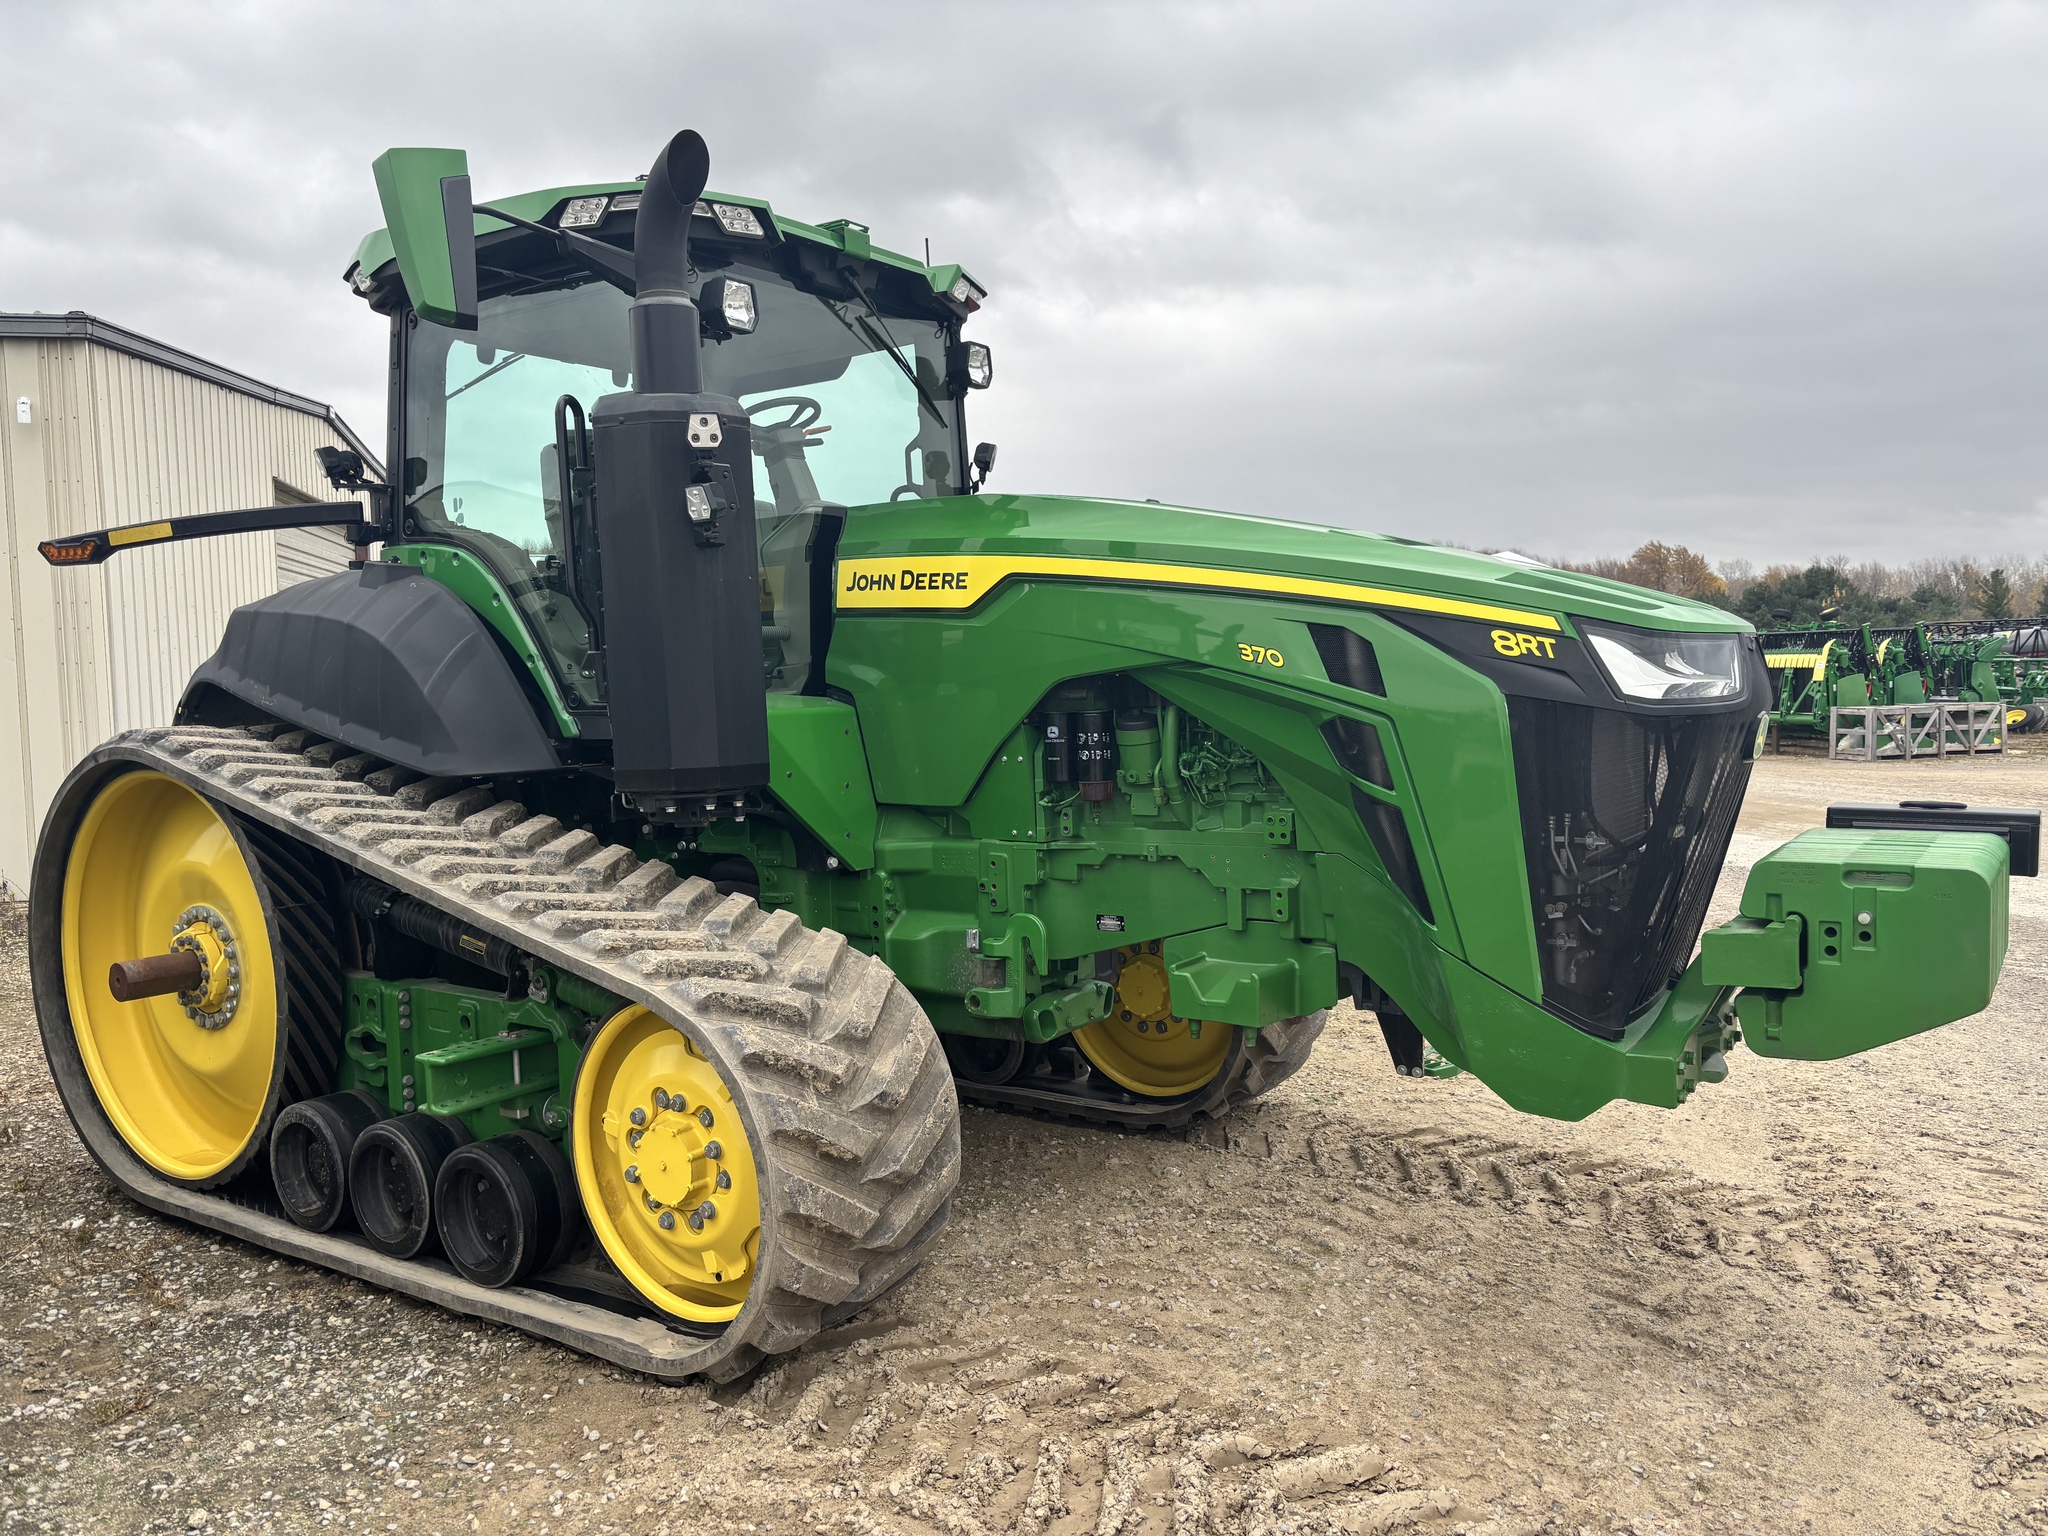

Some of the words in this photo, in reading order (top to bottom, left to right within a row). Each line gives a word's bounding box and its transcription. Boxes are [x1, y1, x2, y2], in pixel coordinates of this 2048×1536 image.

[846, 572, 896, 592] JOHN
[900, 570, 968, 590] DEERE
[1237, 642, 1285, 668] 370
[1490, 629, 1556, 659] 8RT
